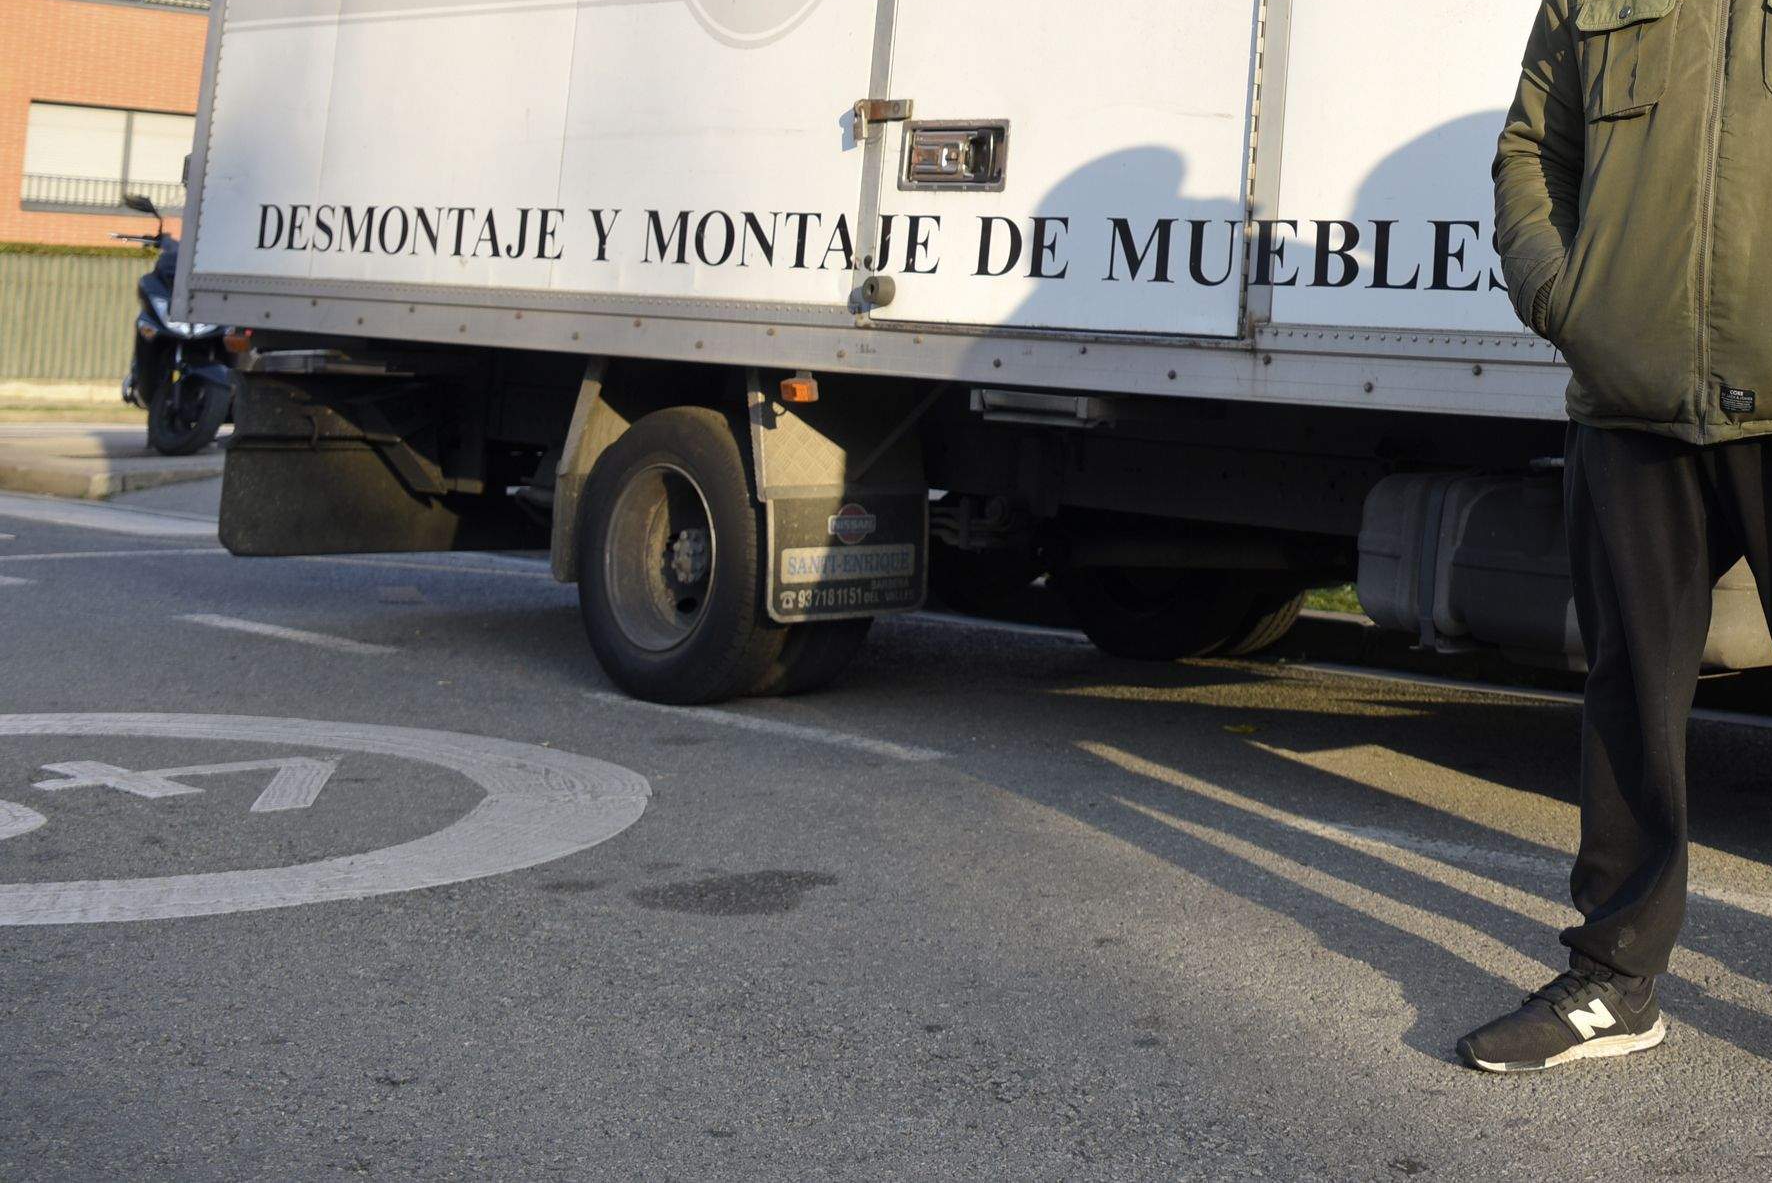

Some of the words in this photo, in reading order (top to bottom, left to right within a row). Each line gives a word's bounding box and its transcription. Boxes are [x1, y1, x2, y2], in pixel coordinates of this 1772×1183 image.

[256, 203, 566, 261] DESMONTAJE
[591, 208, 623, 262] Y
[640, 209, 941, 275] MONTAJE
[970, 215, 1070, 280] DE
[1101, 217, 1511, 293] MUEBLE
